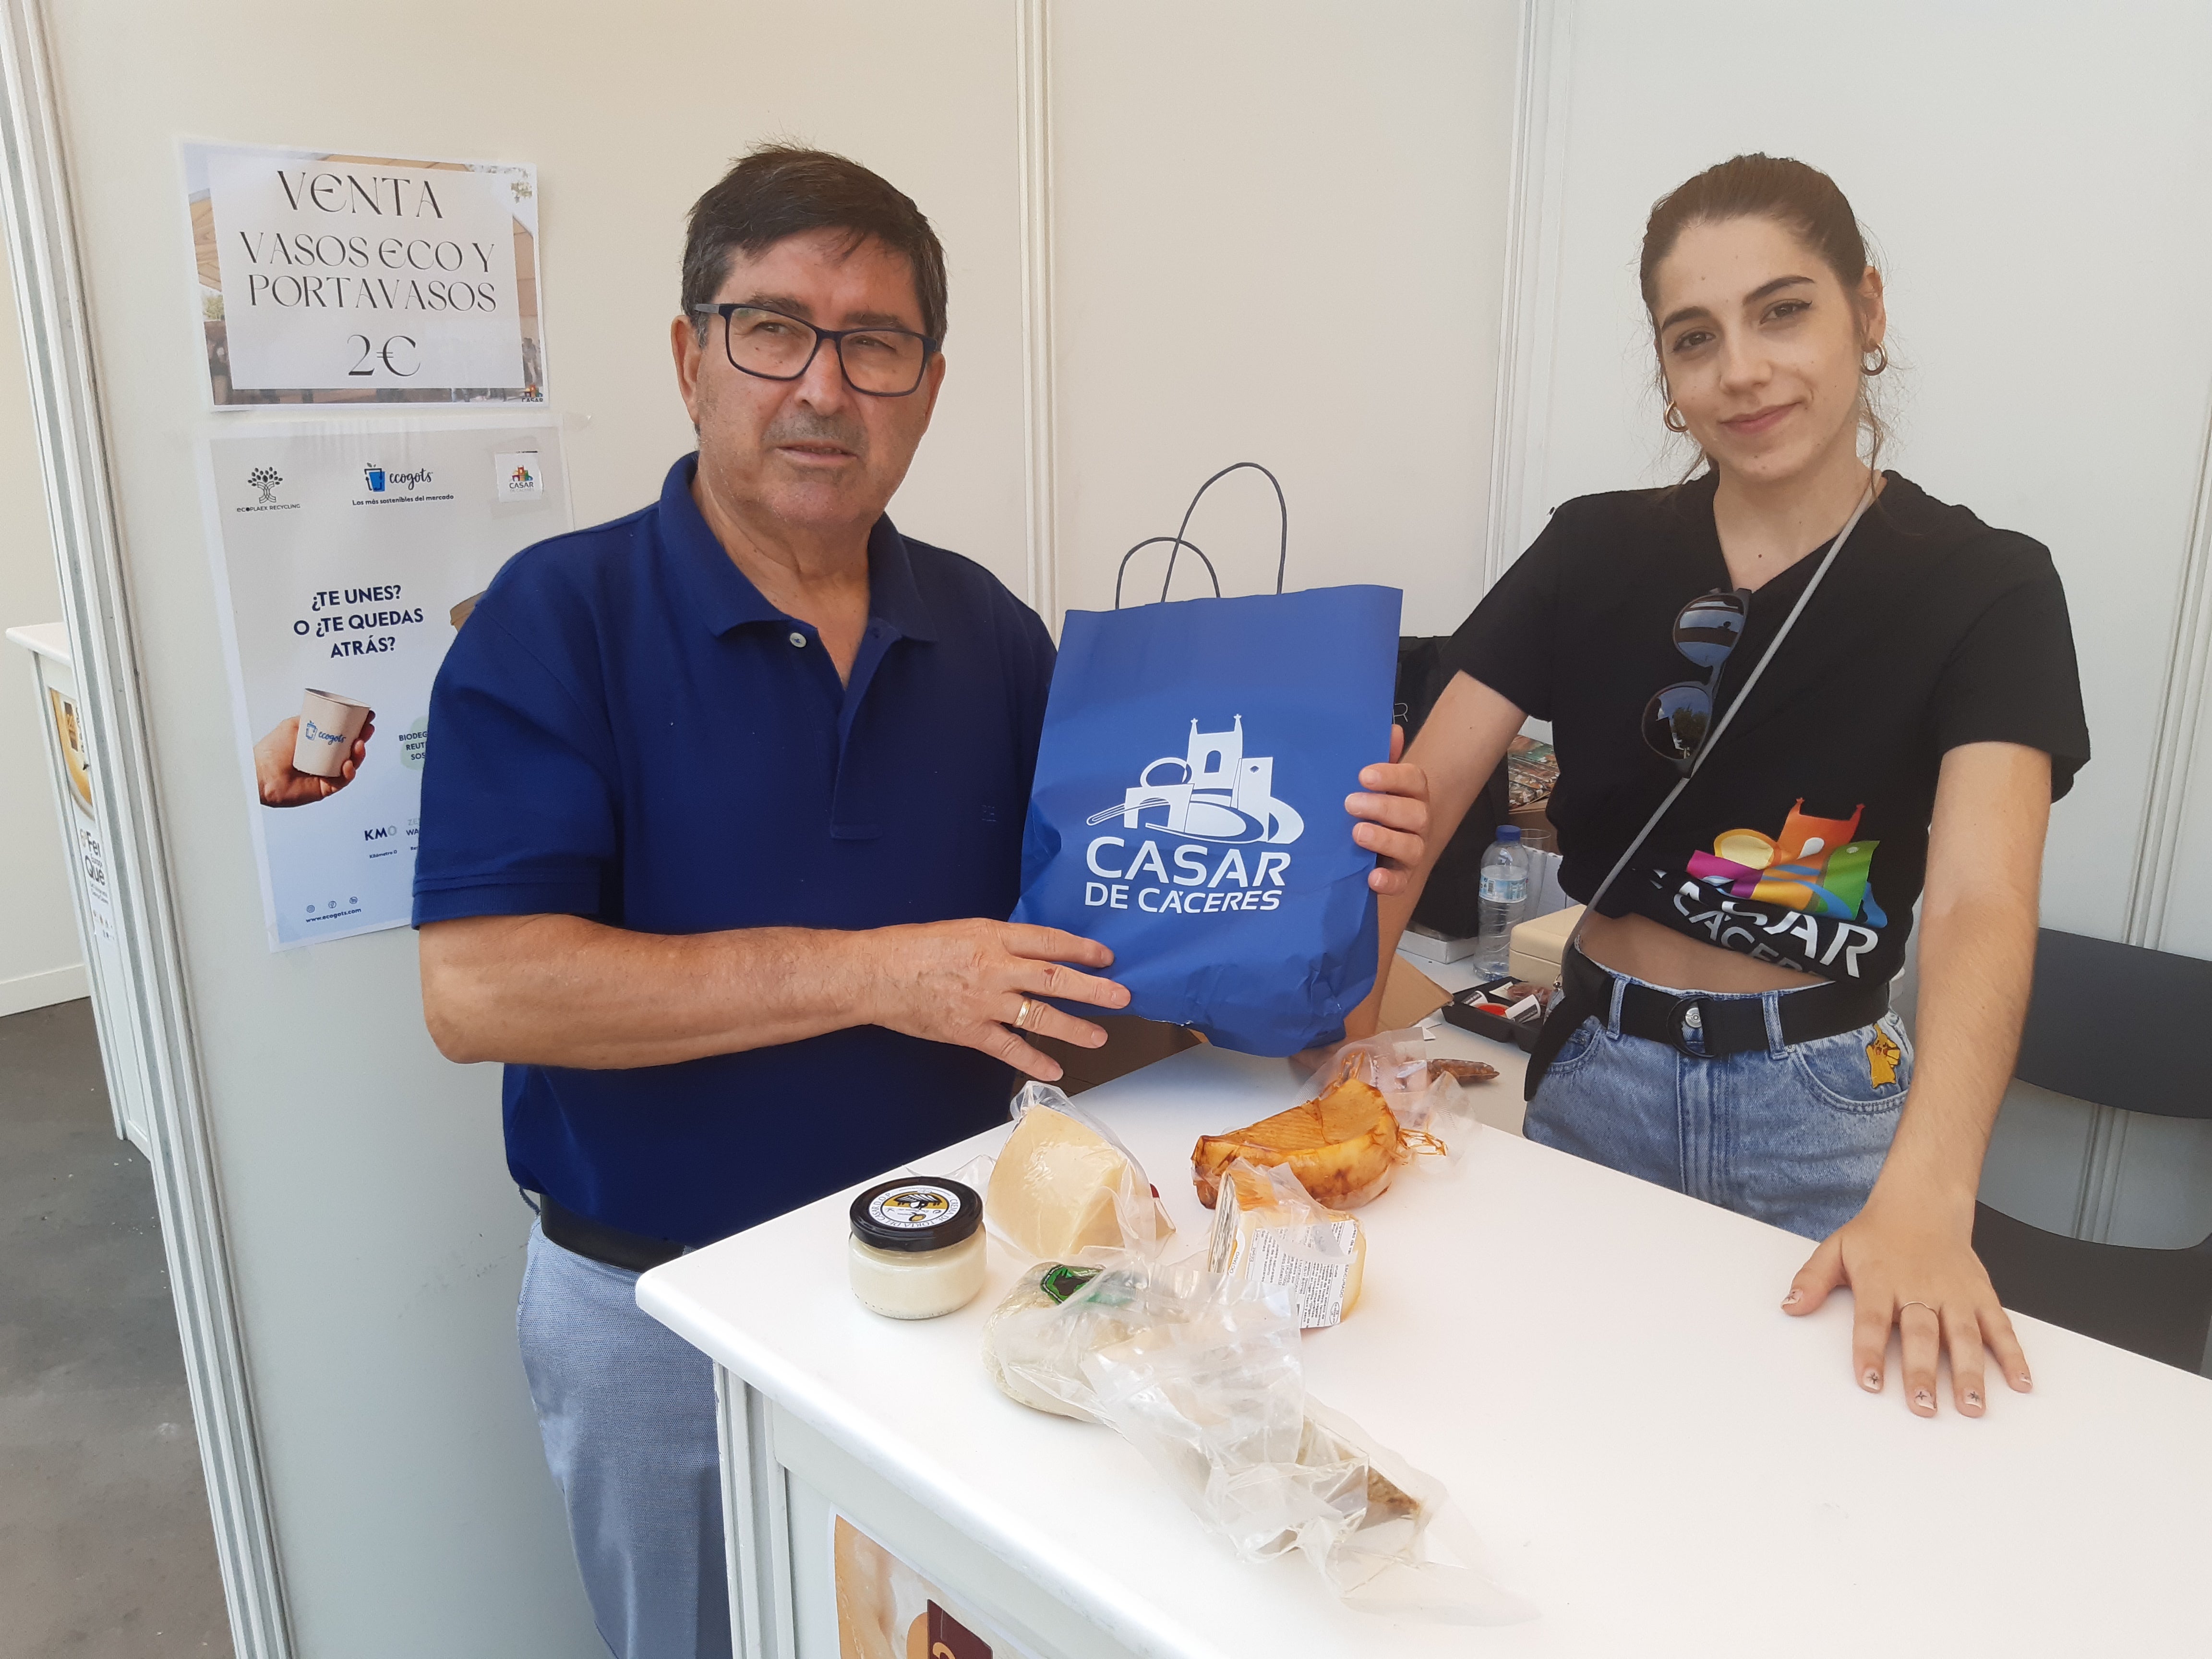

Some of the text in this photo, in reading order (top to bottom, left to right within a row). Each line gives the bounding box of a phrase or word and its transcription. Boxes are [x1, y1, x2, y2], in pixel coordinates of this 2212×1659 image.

[277, 170, 443, 219] VENTA
[240, 231, 495, 273] VASOS ECO Y
[248, 274, 496, 313] PORTAVASOS
[347, 334, 421, 377] 2€
[389, 468, 432, 490] ecogots
[312, 585, 401, 611] ¿TE UNES?
[294, 608, 424, 637] O ¿TE QUEDAS
[331, 635, 396, 658] ATRÁS?
[319, 732, 346, 745] ecogots
[408, 817, 421, 826] ZE
[1086, 836, 1291, 888] CASAR
[1085, 882, 1282, 914] DE CÁCERES
[306, 909, 361, 923] www.ecogots.com
[871, 1206, 885, 1220] CASAR
[948, 1199, 958, 1215] CREMA
[1229, 1251, 1240, 1274] OCTAVO
